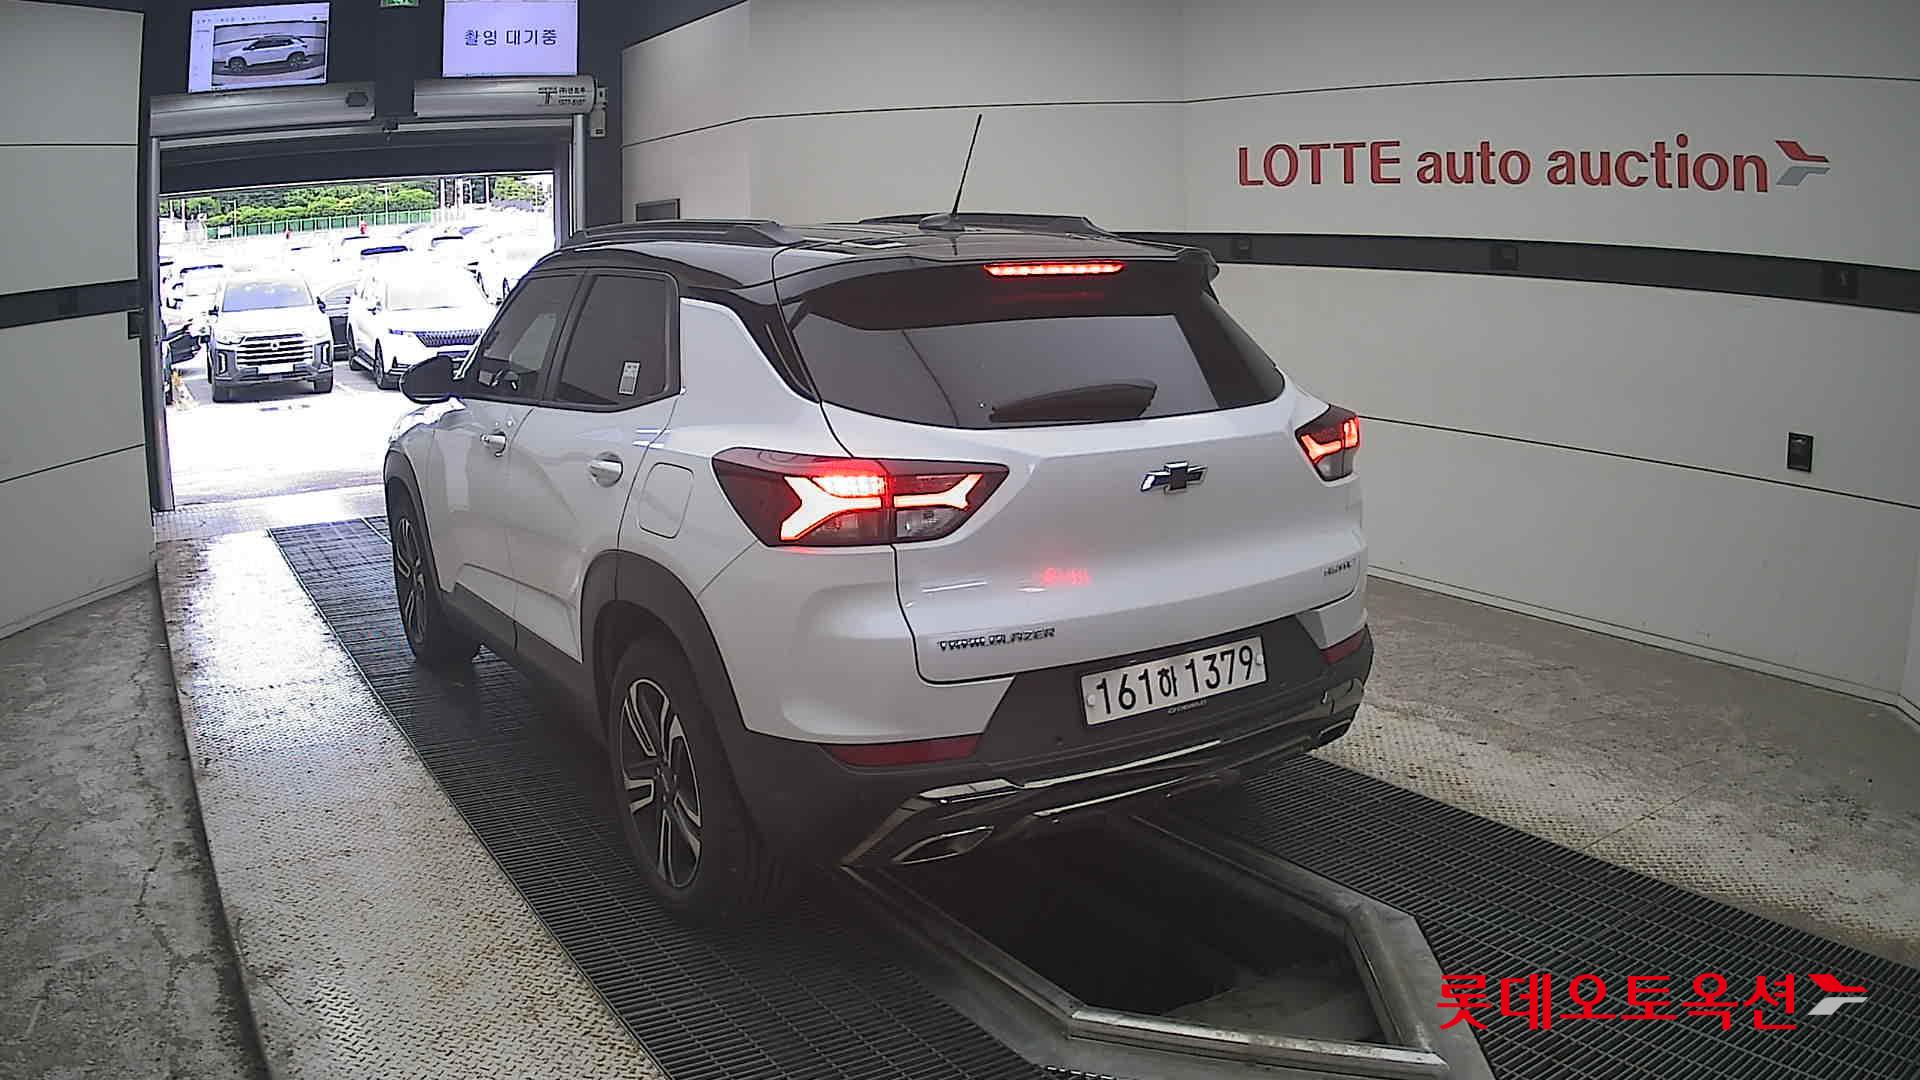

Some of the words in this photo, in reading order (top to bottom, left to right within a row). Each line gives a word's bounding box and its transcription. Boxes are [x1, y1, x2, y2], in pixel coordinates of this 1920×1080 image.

[464, 29, 497, 46] 촬영
[505, 28, 558, 46] 대기중
[1238, 140, 1400, 187] LOTTE
[1415, 141, 1531, 185] auto
[1546, 134, 1769, 193] auction
[1096, 665, 1178, 715] 161하
[1185, 645, 1254, 694] 1379
